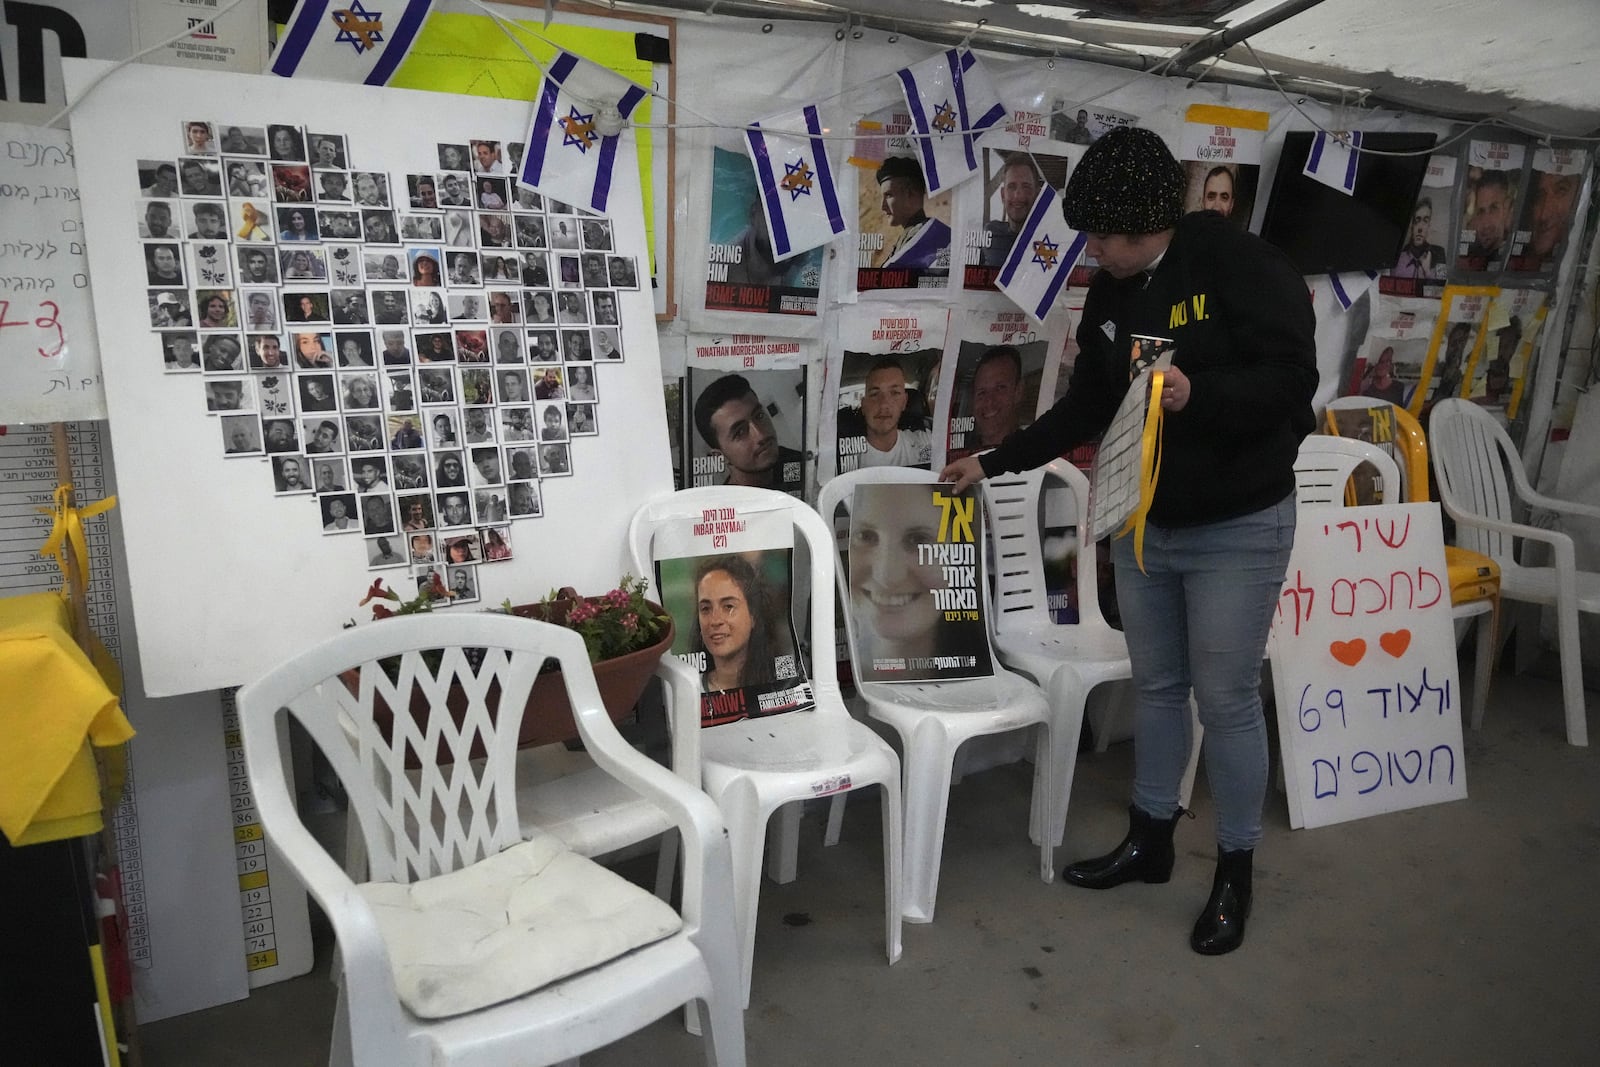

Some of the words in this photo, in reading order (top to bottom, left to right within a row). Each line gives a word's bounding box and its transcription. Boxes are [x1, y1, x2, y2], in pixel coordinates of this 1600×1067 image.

[1026, 124, 1047, 136] PERETZ
[858, 232, 884, 250] RING
[709, 243, 742, 264] BRING
[707, 263, 730, 283] HIM
[858, 270, 879, 288] OME
[738, 286, 770, 306] NOW!
[872, 330, 885, 341] BAR
[696, 345, 729, 358] YONATHAN
[730, 345, 766, 356] MORDECHAI
[903, 339, 921, 352] 23
[743, 356, 755, 368] (21)
[950, 416, 976, 433] BRING
[90, 432, 97, 441] 2
[949, 432, 966, 449] HIM
[92, 444, 98, 453] 3
[839, 435, 867, 455] BRING
[25, 458, 55, 467] אלגרט
[92, 455, 98, 464] 4
[692, 455, 726, 476] BRING
[93, 467, 100, 476] 5
[94, 479, 101, 488] 6
[95, 489, 102, 498] 7
[98, 512, 105, 521] 9
[717, 507, 736, 520] ענבר
[932, 491, 975, 543] אל
[94, 524, 106, 533] 10
[694, 523, 715, 537] INBAR
[1323, 512, 1411, 553] שירי
[95, 535, 107, 544] 11
[713, 535, 728, 548] (27)
[96, 546, 108, 556] 12
[917, 543, 976, 566] תשאירו
[97, 558, 109, 567] 13
[98, 569, 110, 578] 14
[942, 565, 976, 588] אותי
[99, 581, 111, 590] 15
[100, 592, 112, 601] 16
[930, 587, 978, 611] מאחור
[102, 603, 113, 612] 17
[103, 614, 115, 624] 18
[945, 610, 962, 622] ביבס
[962, 610, 979, 621] שירי
[104, 626, 116, 635] 19
[105, 637, 117, 647] 20
[676, 651, 707, 673] RING
[1367, 666, 1451, 718] ולעוד
[713, 688, 747, 713] NOW!
[1298, 683, 1347, 733] 69
[232, 765, 245, 776] 21
[1312, 744, 1455, 799] חטופים
[233, 781, 249, 792] 75
[236, 797, 251, 808] 20
[237, 813, 252, 823] 86
[240, 828, 254, 839] 28
[241, 843, 256, 855] 70
[243, 859, 257, 871] 19
[247, 891, 261, 903] 19
[248, 907, 262, 919] 22
[249, 922, 264, 933] 40
[251, 938, 266, 950] 74
[253, 954, 267, 966] 34
